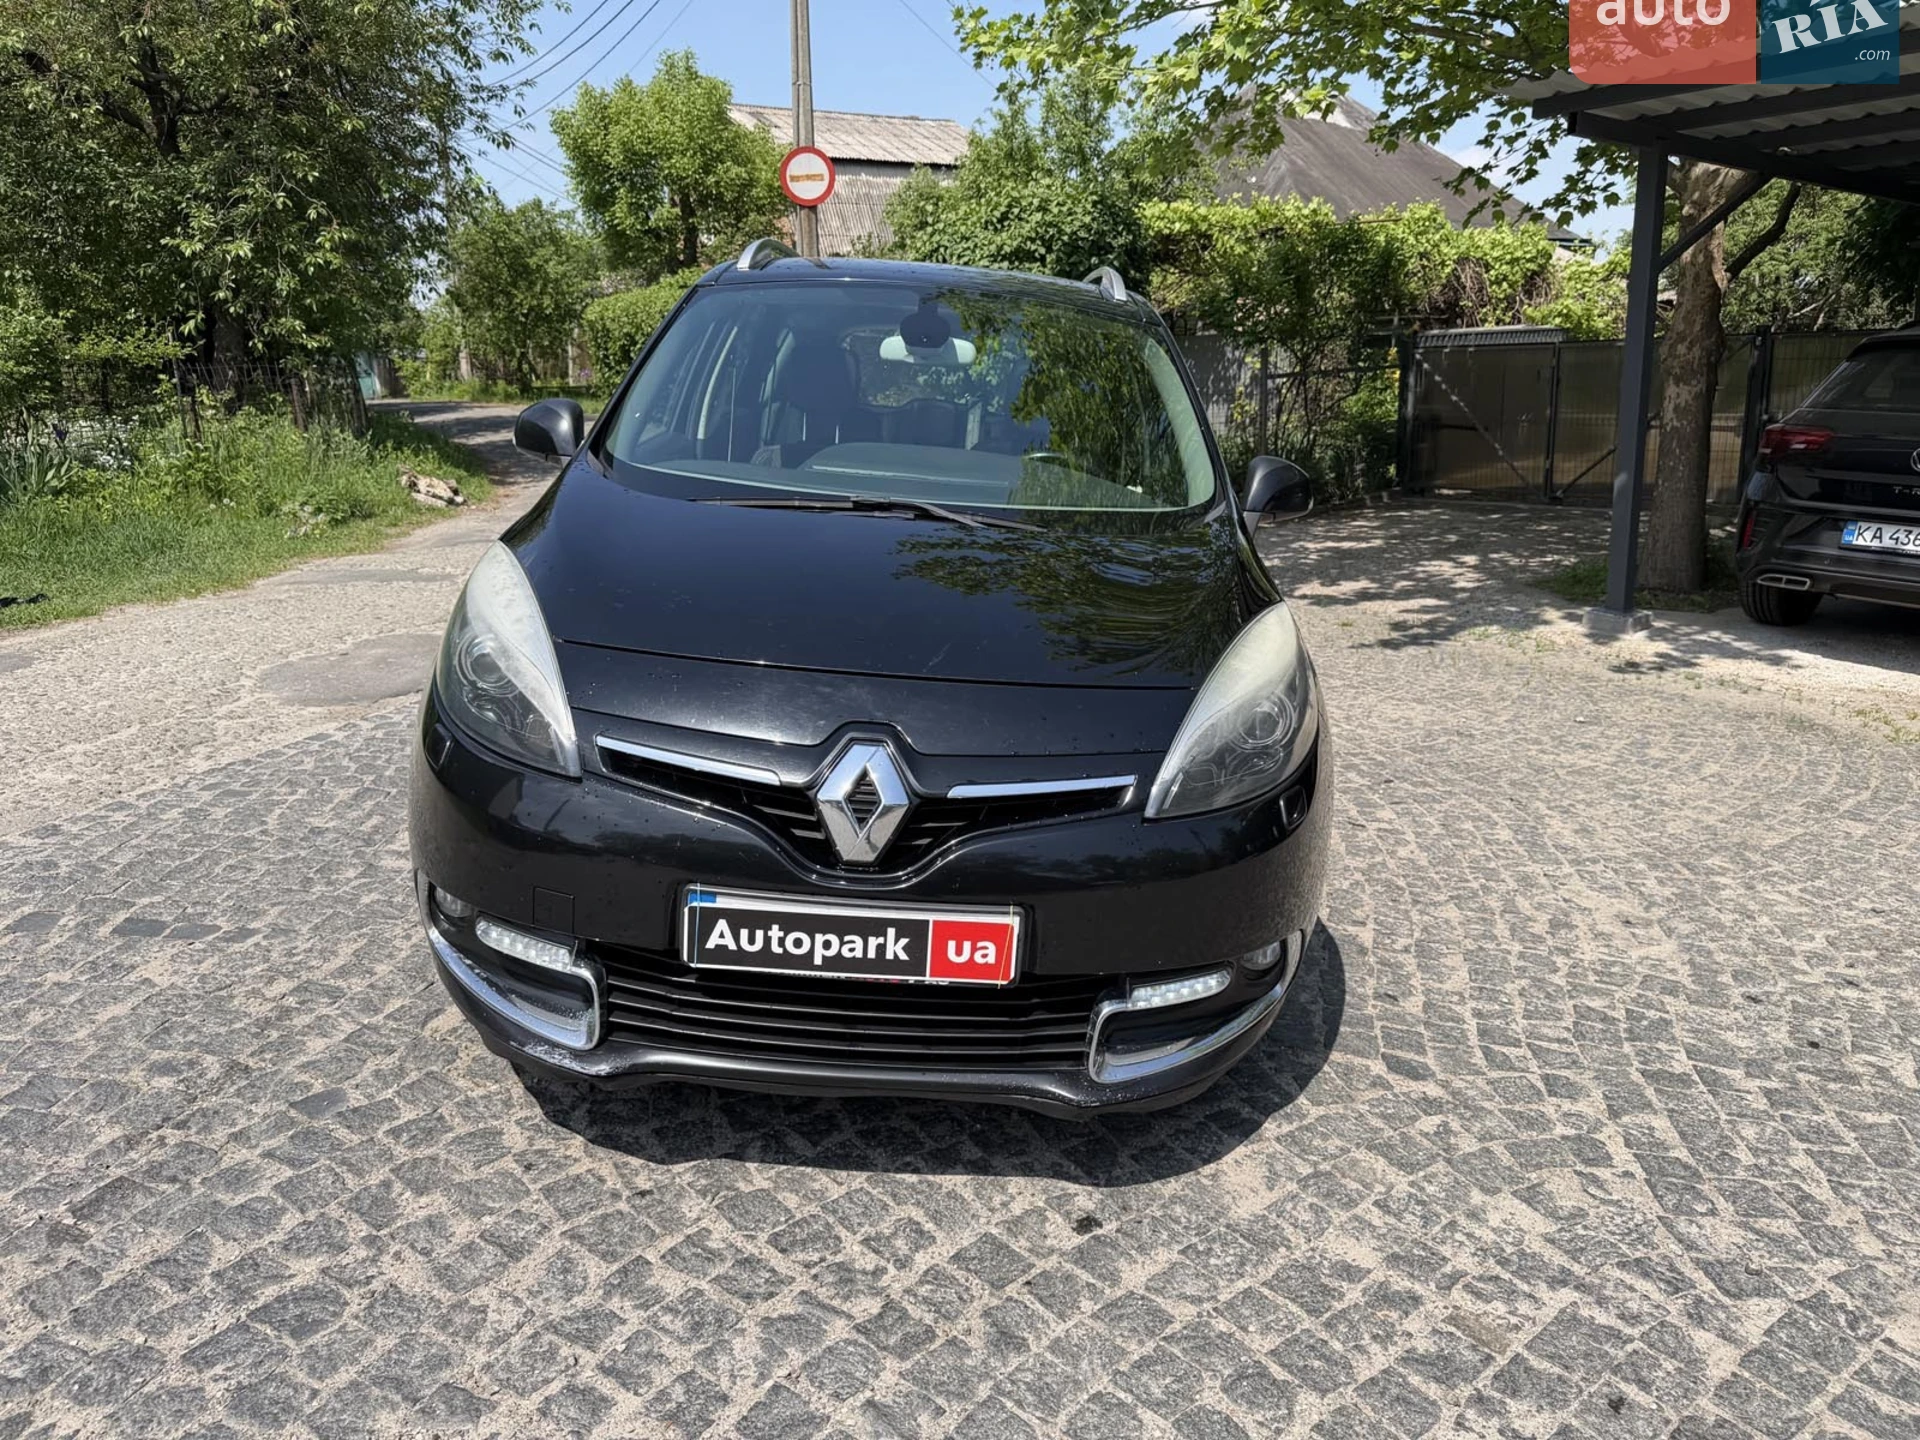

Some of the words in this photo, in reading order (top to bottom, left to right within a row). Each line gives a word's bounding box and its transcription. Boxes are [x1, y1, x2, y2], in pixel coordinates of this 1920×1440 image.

[1856, 526, 1883, 544] KA
[706, 919, 909, 965] Autopark
[947, 940, 996, 965] ua
